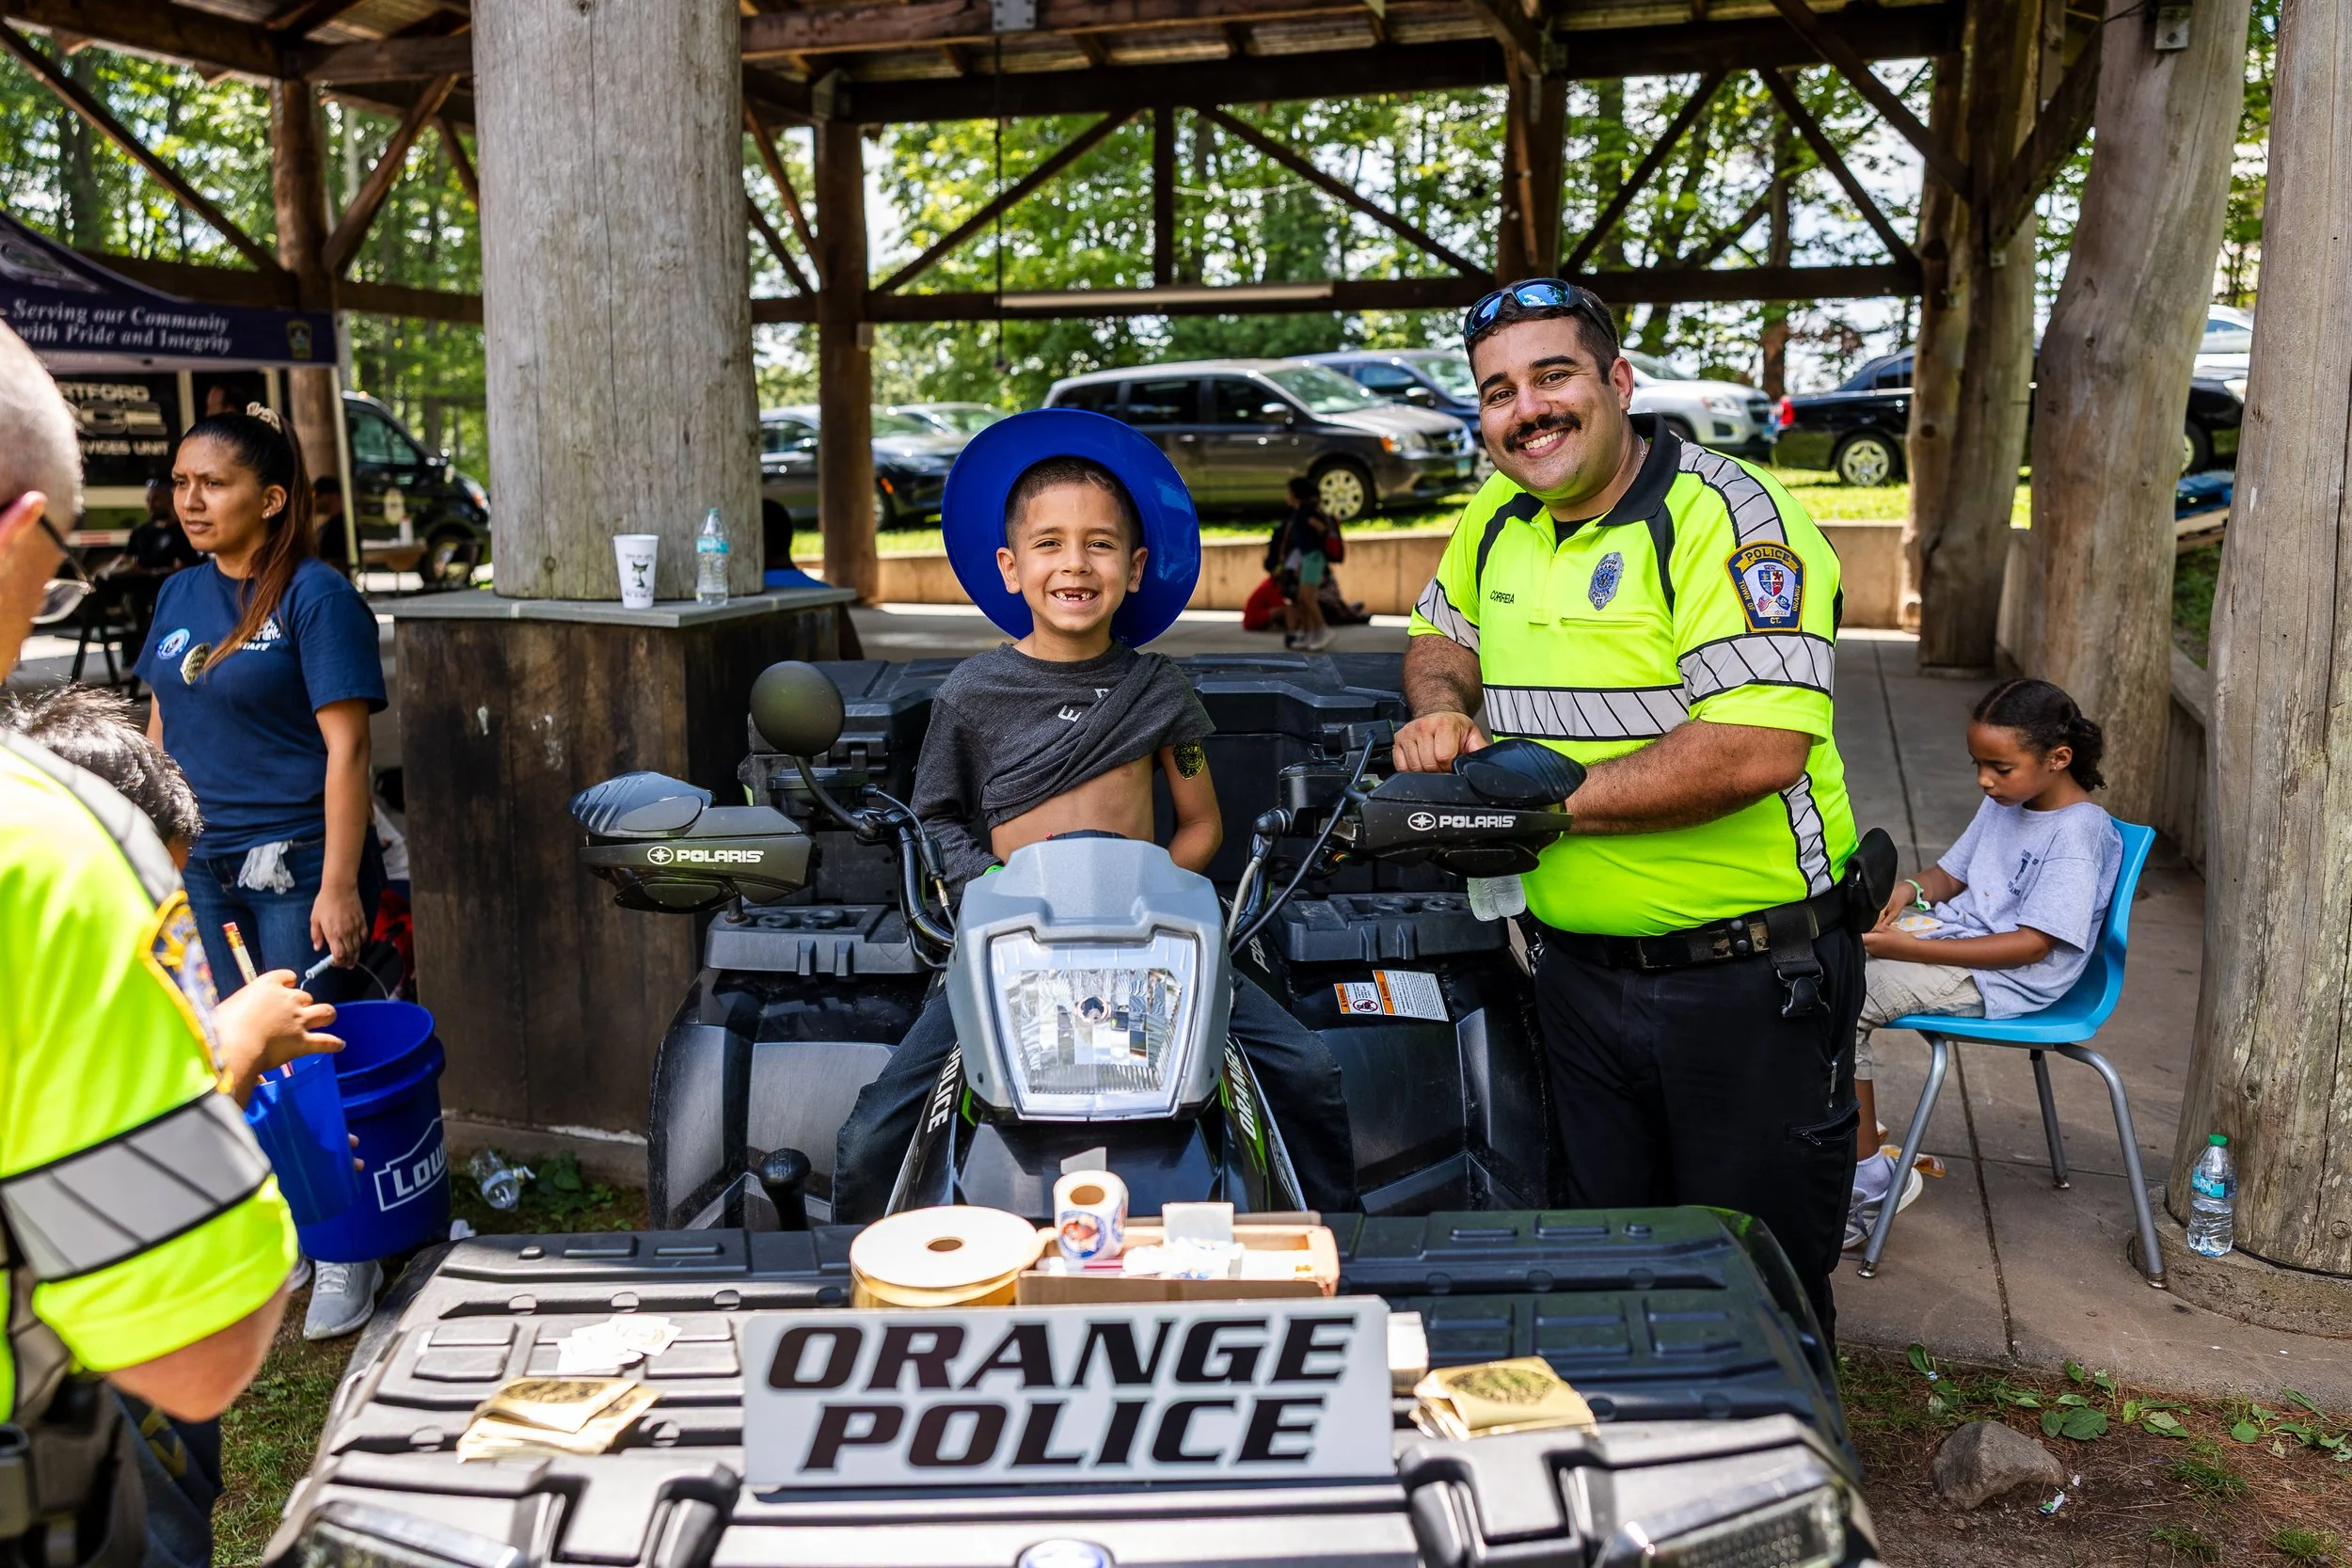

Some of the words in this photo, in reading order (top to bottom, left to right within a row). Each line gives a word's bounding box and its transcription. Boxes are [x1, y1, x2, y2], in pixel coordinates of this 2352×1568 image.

[13, 298, 87, 325] Serving
[93, 308, 126, 325] our
[130, 307, 230, 334] Community
[18, 323, 58, 342] with
[65, 325, 115, 345] Pride
[119, 329, 154, 346] and
[159, 330, 232, 355] Integrity
[133, 440, 169, 456] UNIT
[1745, 548, 1790, 562] POLICE
[1739, 579, 1752, 601] TOWN
[1747, 602, 1756, 611] OF
[1791, 583, 1802, 612] ORANGE
[1438, 815, 1514, 829] POLARIS
[676, 849, 762, 863] POLARIS
[927, 1047, 962, 1133] POLICE
[766, 1314, 1358, 1391] ORANGE
[797, 1396, 1326, 1474] POLICE
